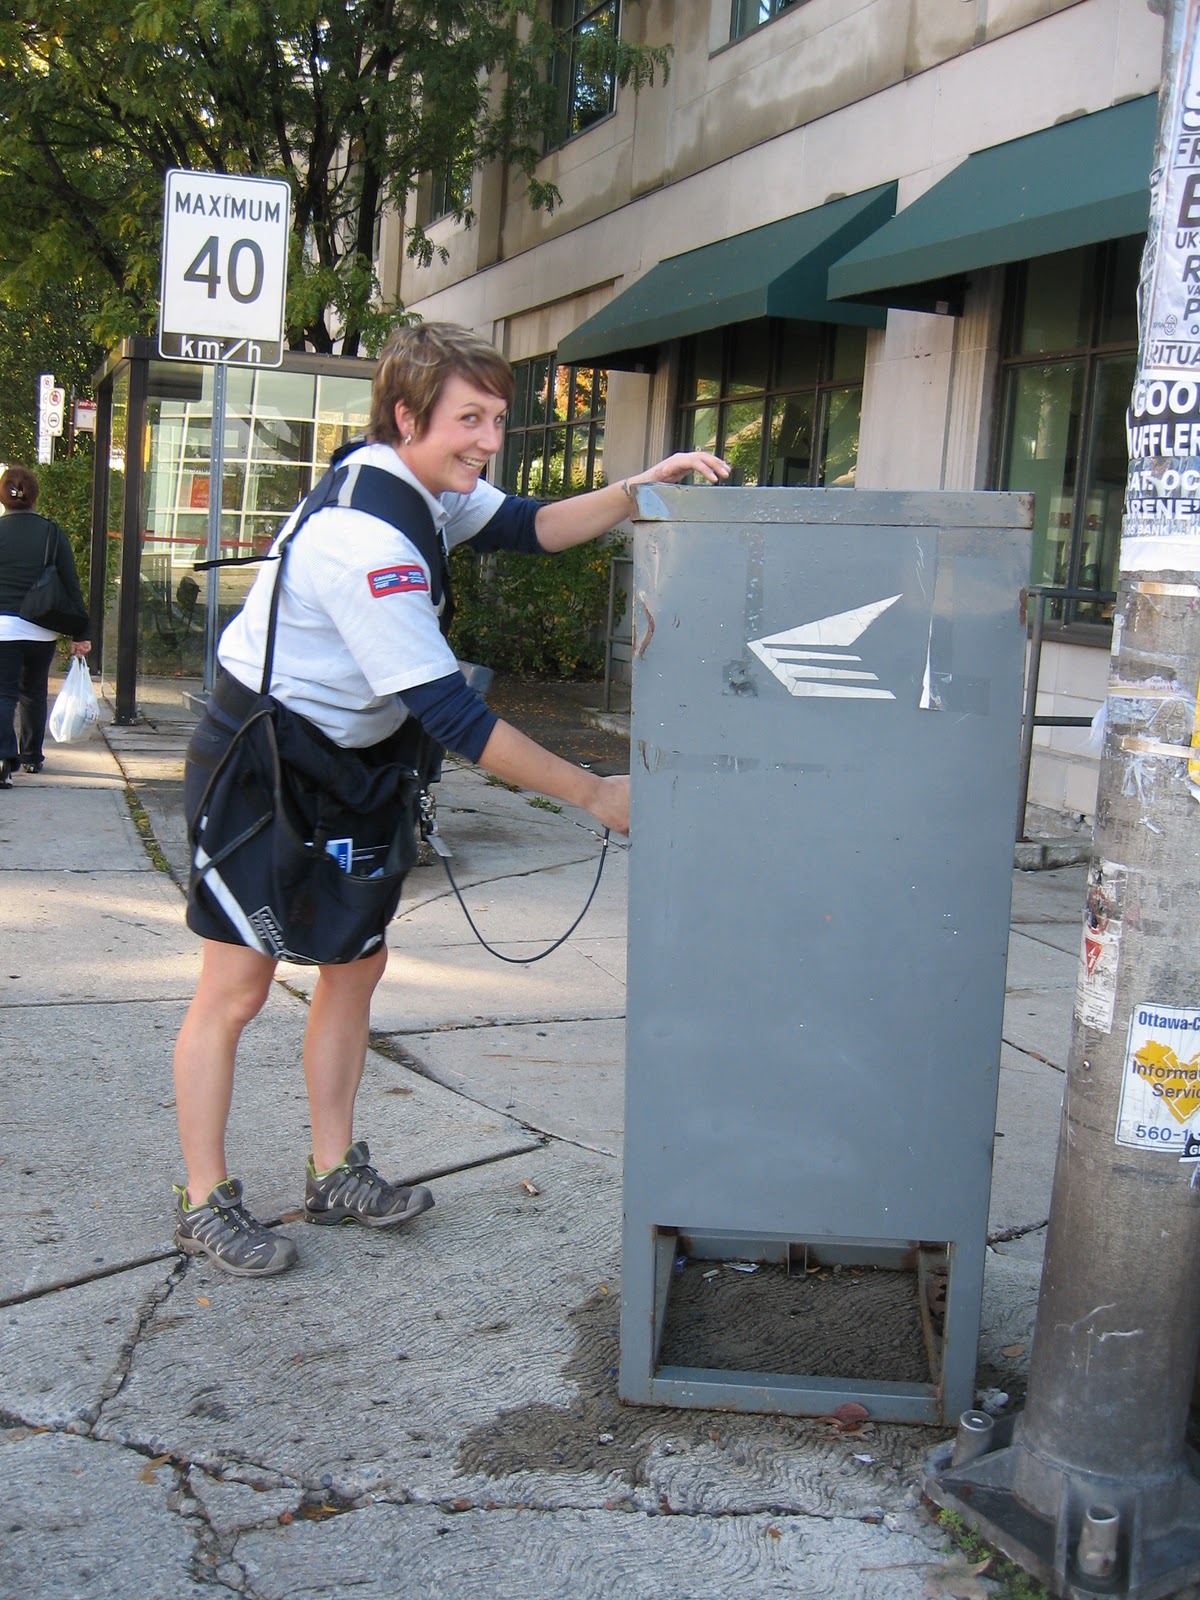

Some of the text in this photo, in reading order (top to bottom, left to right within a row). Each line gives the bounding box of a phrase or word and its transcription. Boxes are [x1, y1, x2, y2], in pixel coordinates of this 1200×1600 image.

[175, 191, 281, 224] MAXIMUM
[1175, 231, 1200, 249] UK
[183, 235, 265, 305] 40
[180, 335, 262, 363] km/h
[1133, 380, 1200, 417] GOO
[1127, 423, 1200, 460] UFFLER
[1136, 523, 1169, 536] BANK
[1138, 1011, 1200, 1031] Ottawa-C
